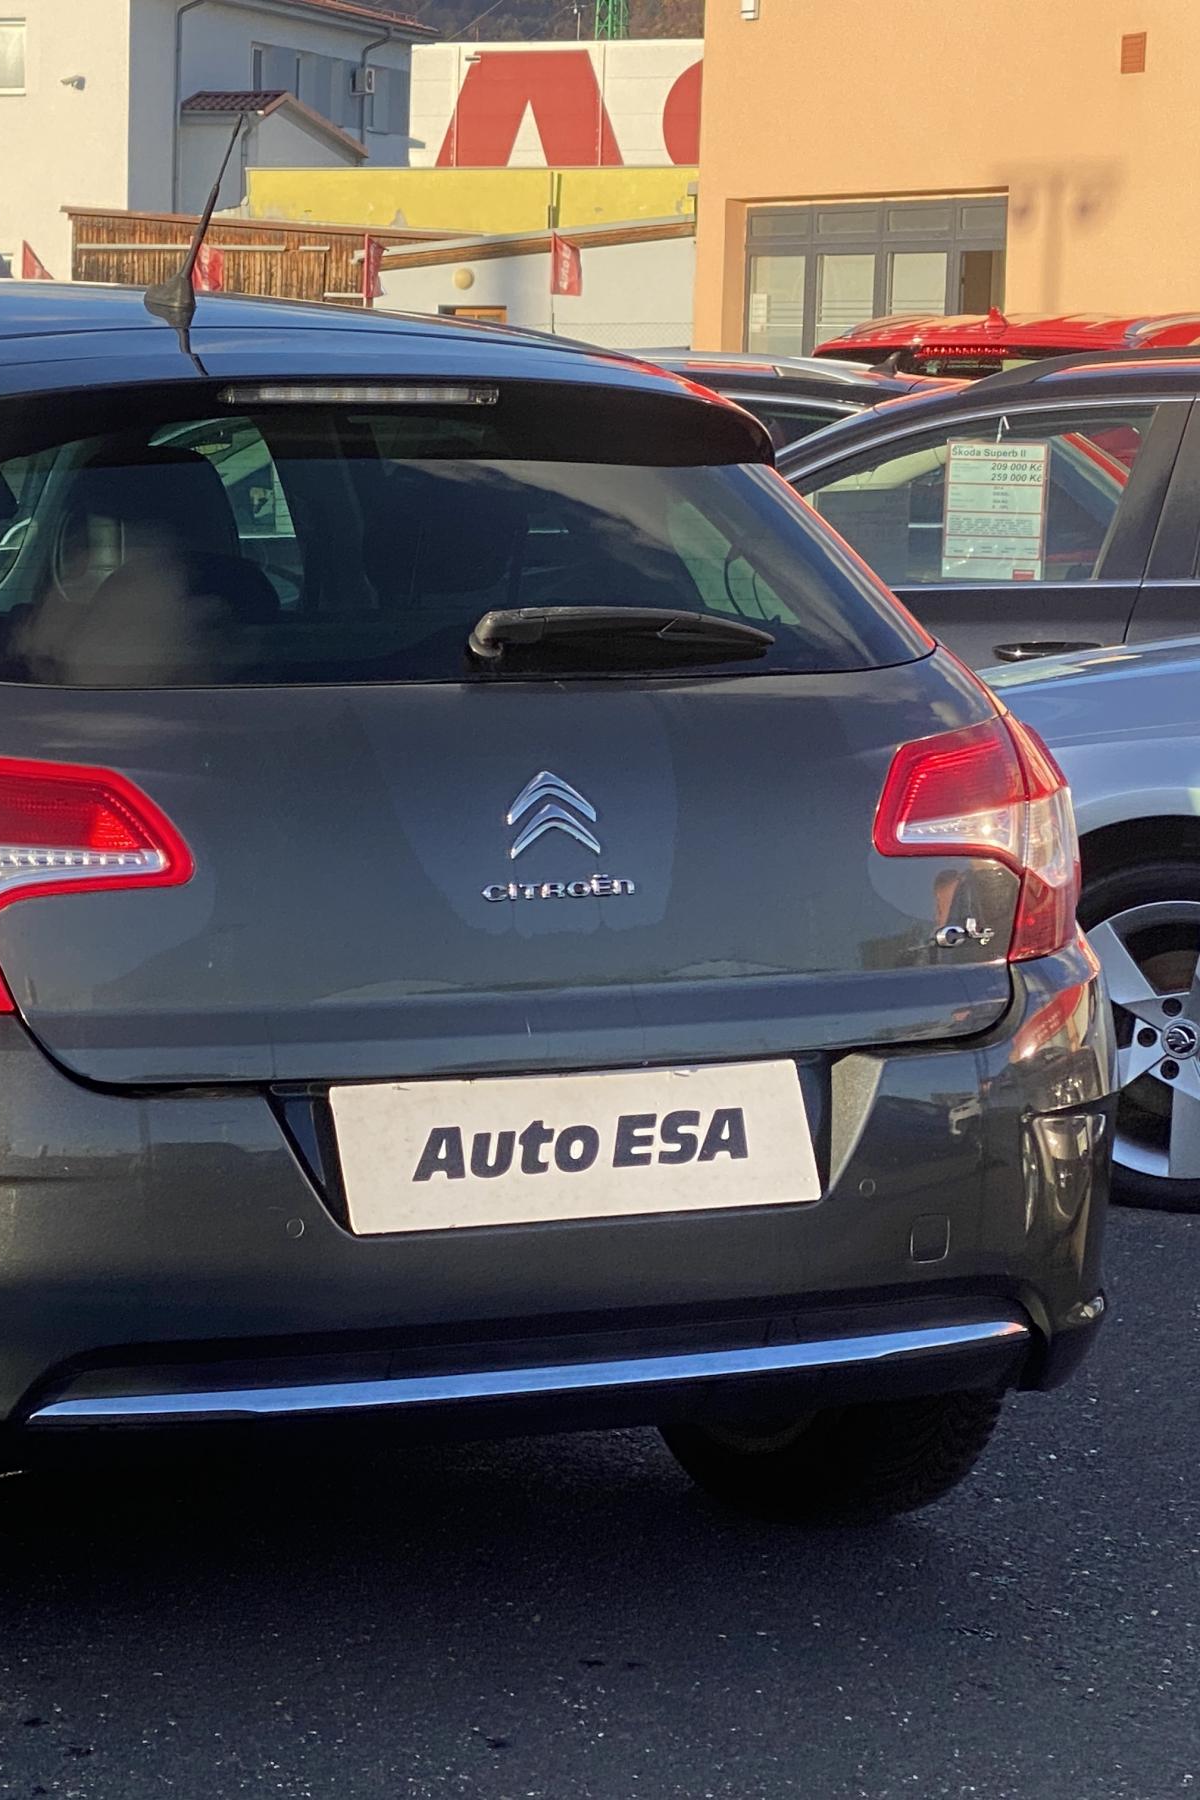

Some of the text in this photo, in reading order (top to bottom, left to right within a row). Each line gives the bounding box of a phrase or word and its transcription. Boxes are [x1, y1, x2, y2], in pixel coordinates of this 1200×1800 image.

[984, 449, 1017, 458] Superb
[991, 463, 1008, 471] 209
[1010, 463, 1027, 472] 000
[991, 473, 1008, 482] 259
[1010, 474, 1027, 482] 000
[412, 1107, 749, 1182] Auto ESA
